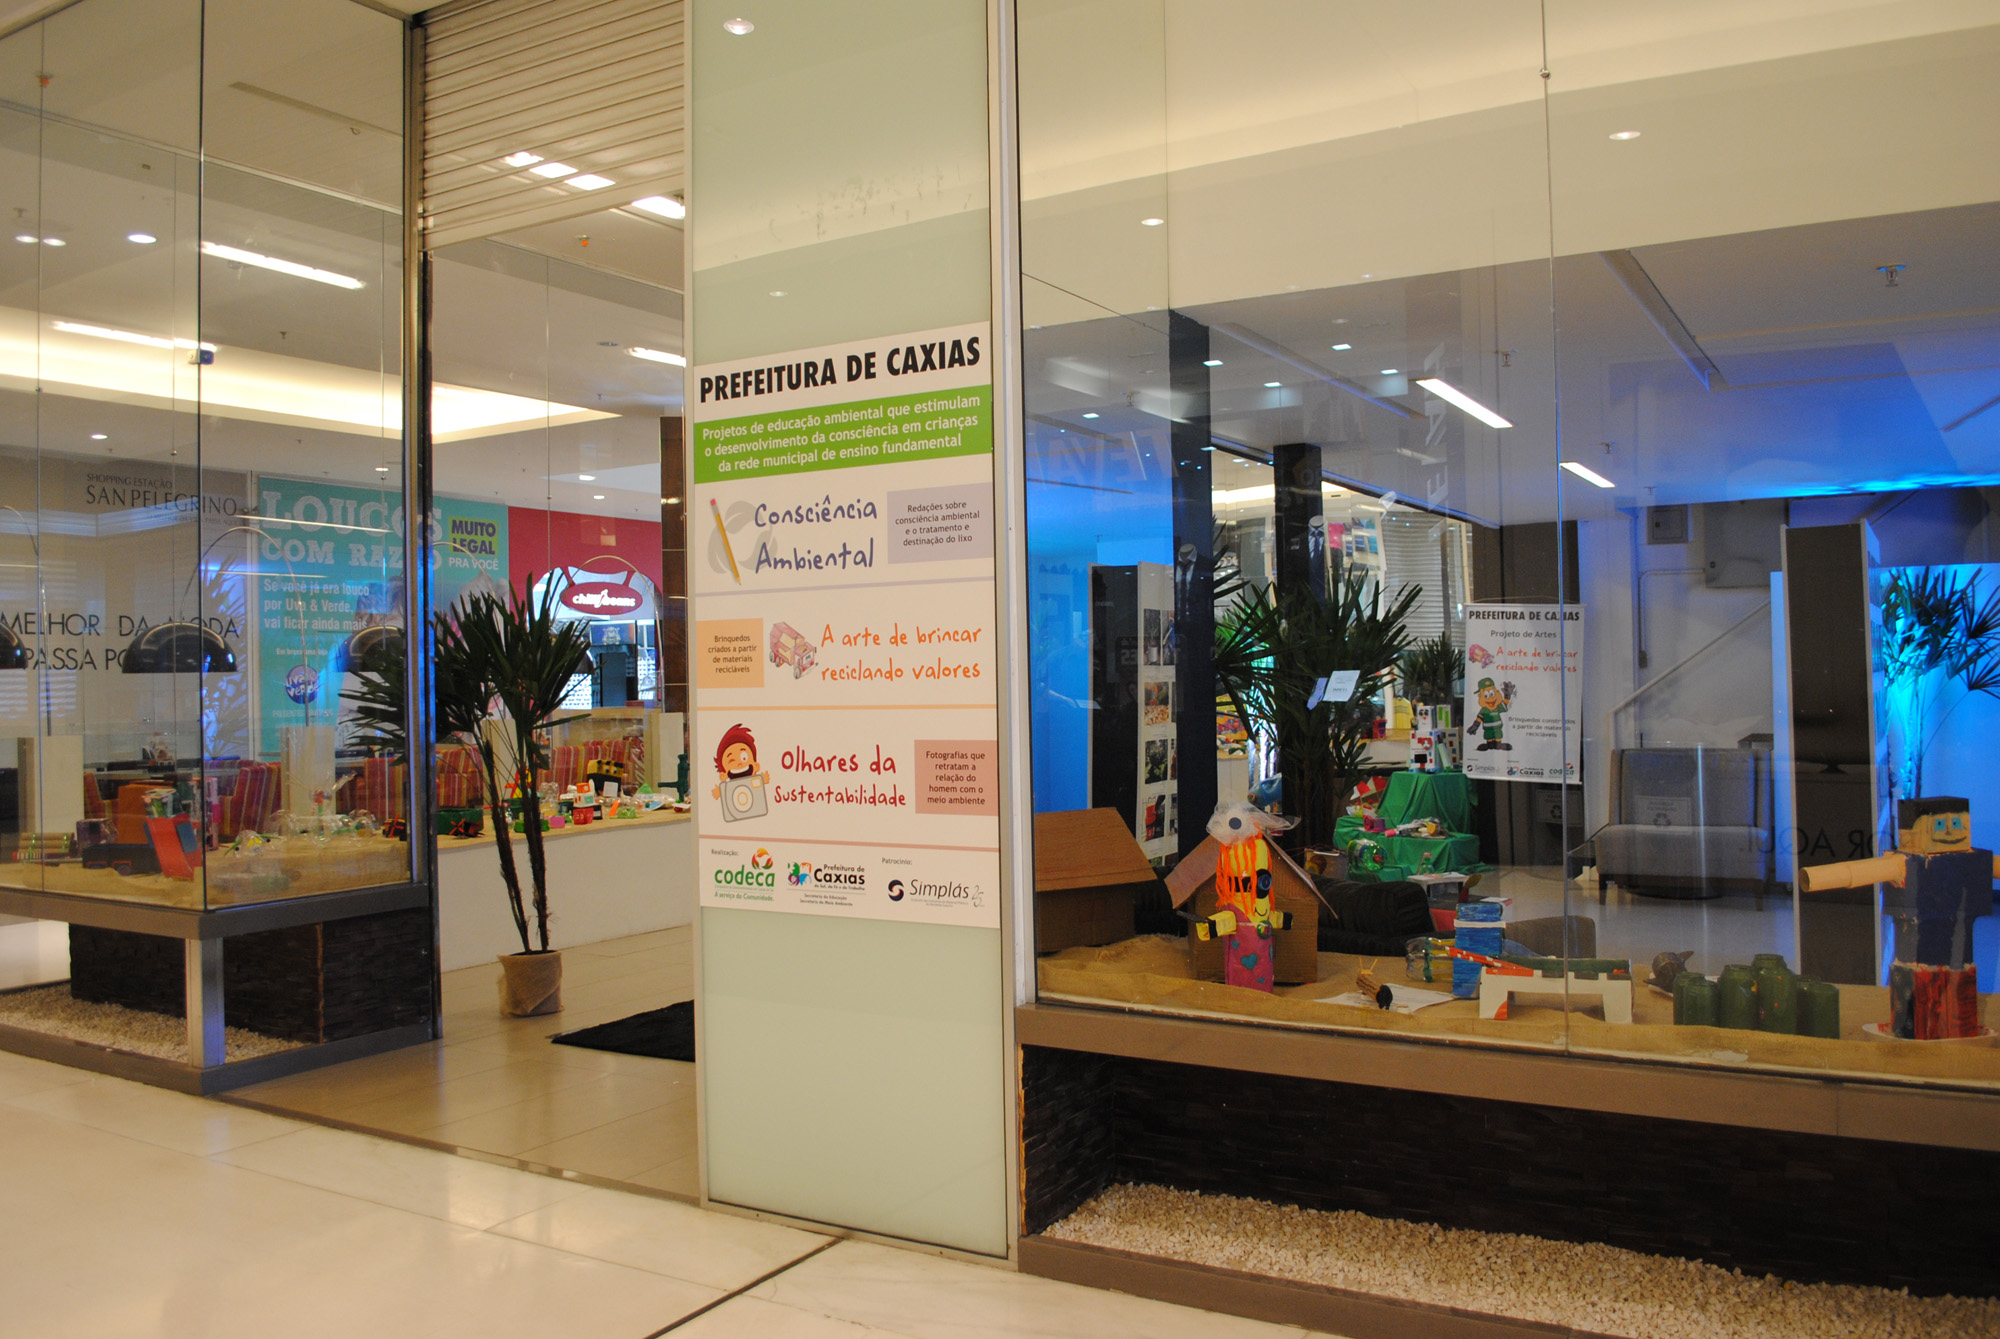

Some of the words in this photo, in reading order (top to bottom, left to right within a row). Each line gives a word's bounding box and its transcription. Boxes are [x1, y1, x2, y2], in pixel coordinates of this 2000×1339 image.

[700, 358, 836, 403] PREFEITURA
[846, 352, 876, 382] DE
[887, 336, 980, 376] CAXIAS
[703, 425, 747, 440] Projetos
[750, 422, 765, 434] de
[767, 414, 821, 432] educação
[824, 406, 883, 425] ambiental
[887, 404, 910, 419] que
[914, 395, 981, 414] estimulam
[705, 446, 712, 457] o
[714, 434, 808, 456] desenvolvimento
[812, 431, 826, 444] da
[828, 422, 899, 442] consciência
[902, 420, 922, 434] em
[925, 414, 978, 432] crianças
[718, 459, 731, 472] da
[734, 456, 759, 471] rede
[762, 450, 818, 468] municipal
[821, 448, 836, 461] de
[839, 444, 878, 459] ensino
[882, 433, 962, 454] fundamental
[87, 473, 132, 486] SHOPPING
[133, 475, 172, 490] ESTAÇÃO
[754, 494, 878, 527] Consciência
[907, 502, 943, 513] Redações
[945, 500, 967, 510] sobre
[895, 514, 939, 525] consciência
[941, 510, 980, 522] ambiental
[452, 519, 496, 537] MUITO
[912, 527, 917, 535] o
[919, 525, 962, 534] tratamento
[452, 537, 496, 555] LEGAL
[903, 536, 944, 548] destinação
[946, 535, 955, 544] do
[957, 534, 972, 543] lixo
[261, 537, 335, 565] COM
[349, 544, 442, 571] RAZO
[755, 537, 874, 574] Ambiental
[448, 558, 470, 568] PRA
[471, 557, 498, 570] VOCÊ
[264, 579, 278, 592] Se
[282, 580, 306, 592] você
[310, 581, 319, 595] já
[323, 584, 339, 594] era
[342, 582, 369, 595] louco
[264, 600, 282, 612] por
[285, 598, 306, 611] Uva
[310, 599, 318, 612] &
[322, 599, 353, 614] Verde,
[1469, 610, 1525, 620] PREFEITURA
[1529, 612, 1541, 620] DE
[1545, 612, 1580, 621] CAIAS
[264, 616, 280, 628] vai
[284, 616, 308, 629] ficar
[312, 617, 339, 630] ainda
[343, 618, 367, 630] mais
[714, 634, 750, 644] Brinquedos
[821, 624, 834, 648] A
[842, 627, 881, 647] arte
[889, 622, 908, 646] de
[916, 622, 982, 644] brincar
[1491, 630, 1520, 638] Projeto
[708, 644, 731, 653] criados
[738, 644, 757, 654] partir
[1496, 646, 1504, 656] A
[1507, 648, 1527, 657] arte
[1532, 648, 1541, 657] de
[722, 654, 753, 663] materiais
[715, 665, 750, 674] recicláveis
[821, 657, 904, 682] reciclando
[912, 657, 981, 680] valores
[1496, 662, 1539, 672] reciclando
[781, 745, 859, 773] Olhares
[870, 744, 896, 775] da
[925, 751, 968, 761] Fotografias
[970, 752, 985, 761] que
[935, 763, 969, 771] retratam
[935, 774, 965, 783] relação
[966, 774, 976, 782] do
[774, 784, 906, 807] Sustentabilidade
[928, 785, 959, 794] homem
[960, 786, 977, 794] com
[927, 796, 946, 804] meio
[948, 796, 985, 805] ambiente
[711, 849, 739, 857] Realização:
[824, 864, 854, 872] Prefeitura
[714, 865, 775, 887] codeca
[814, 868, 865, 885] Caxias
[910, 879, 969, 899] Simplás
